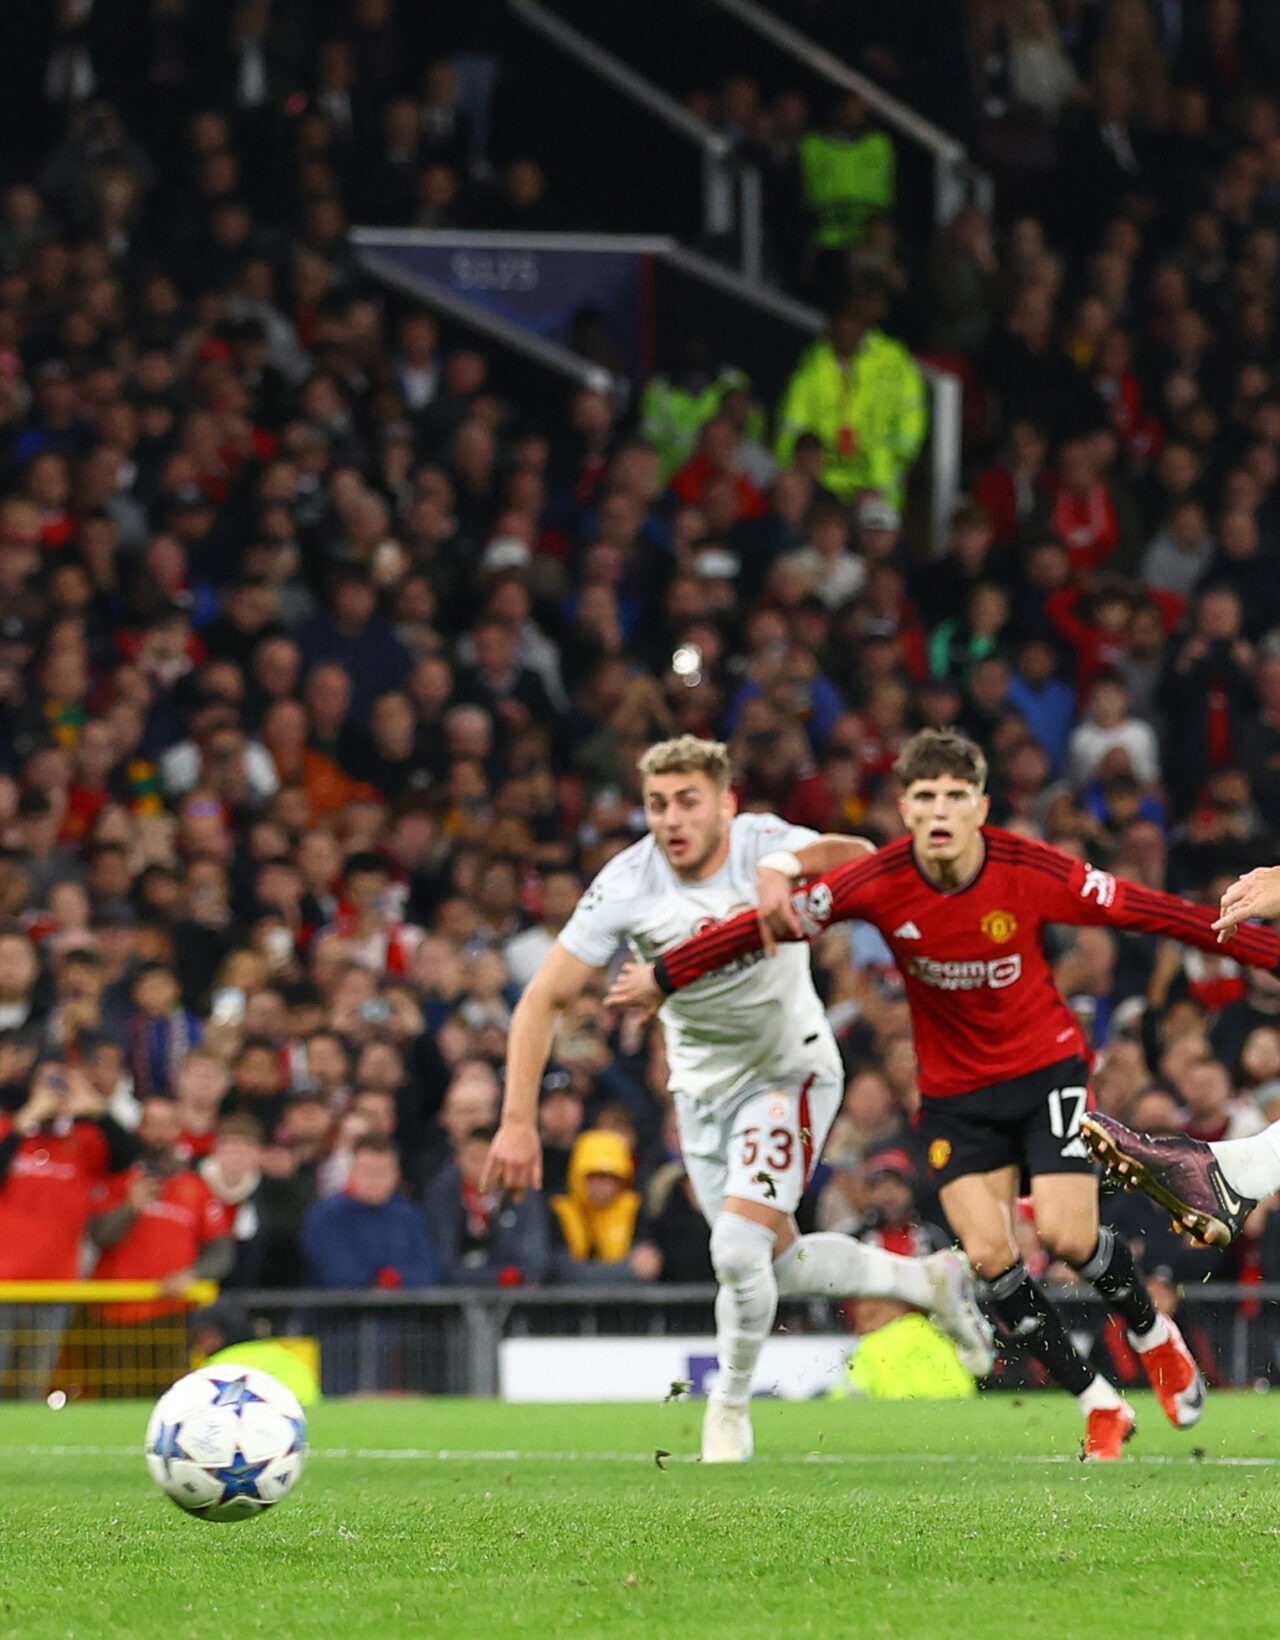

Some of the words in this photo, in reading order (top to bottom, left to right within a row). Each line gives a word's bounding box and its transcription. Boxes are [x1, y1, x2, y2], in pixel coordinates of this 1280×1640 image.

[914, 955, 986, 979] Team
[1047, 1086, 1088, 1139] 17
[740, 1126, 794, 1171] 53
